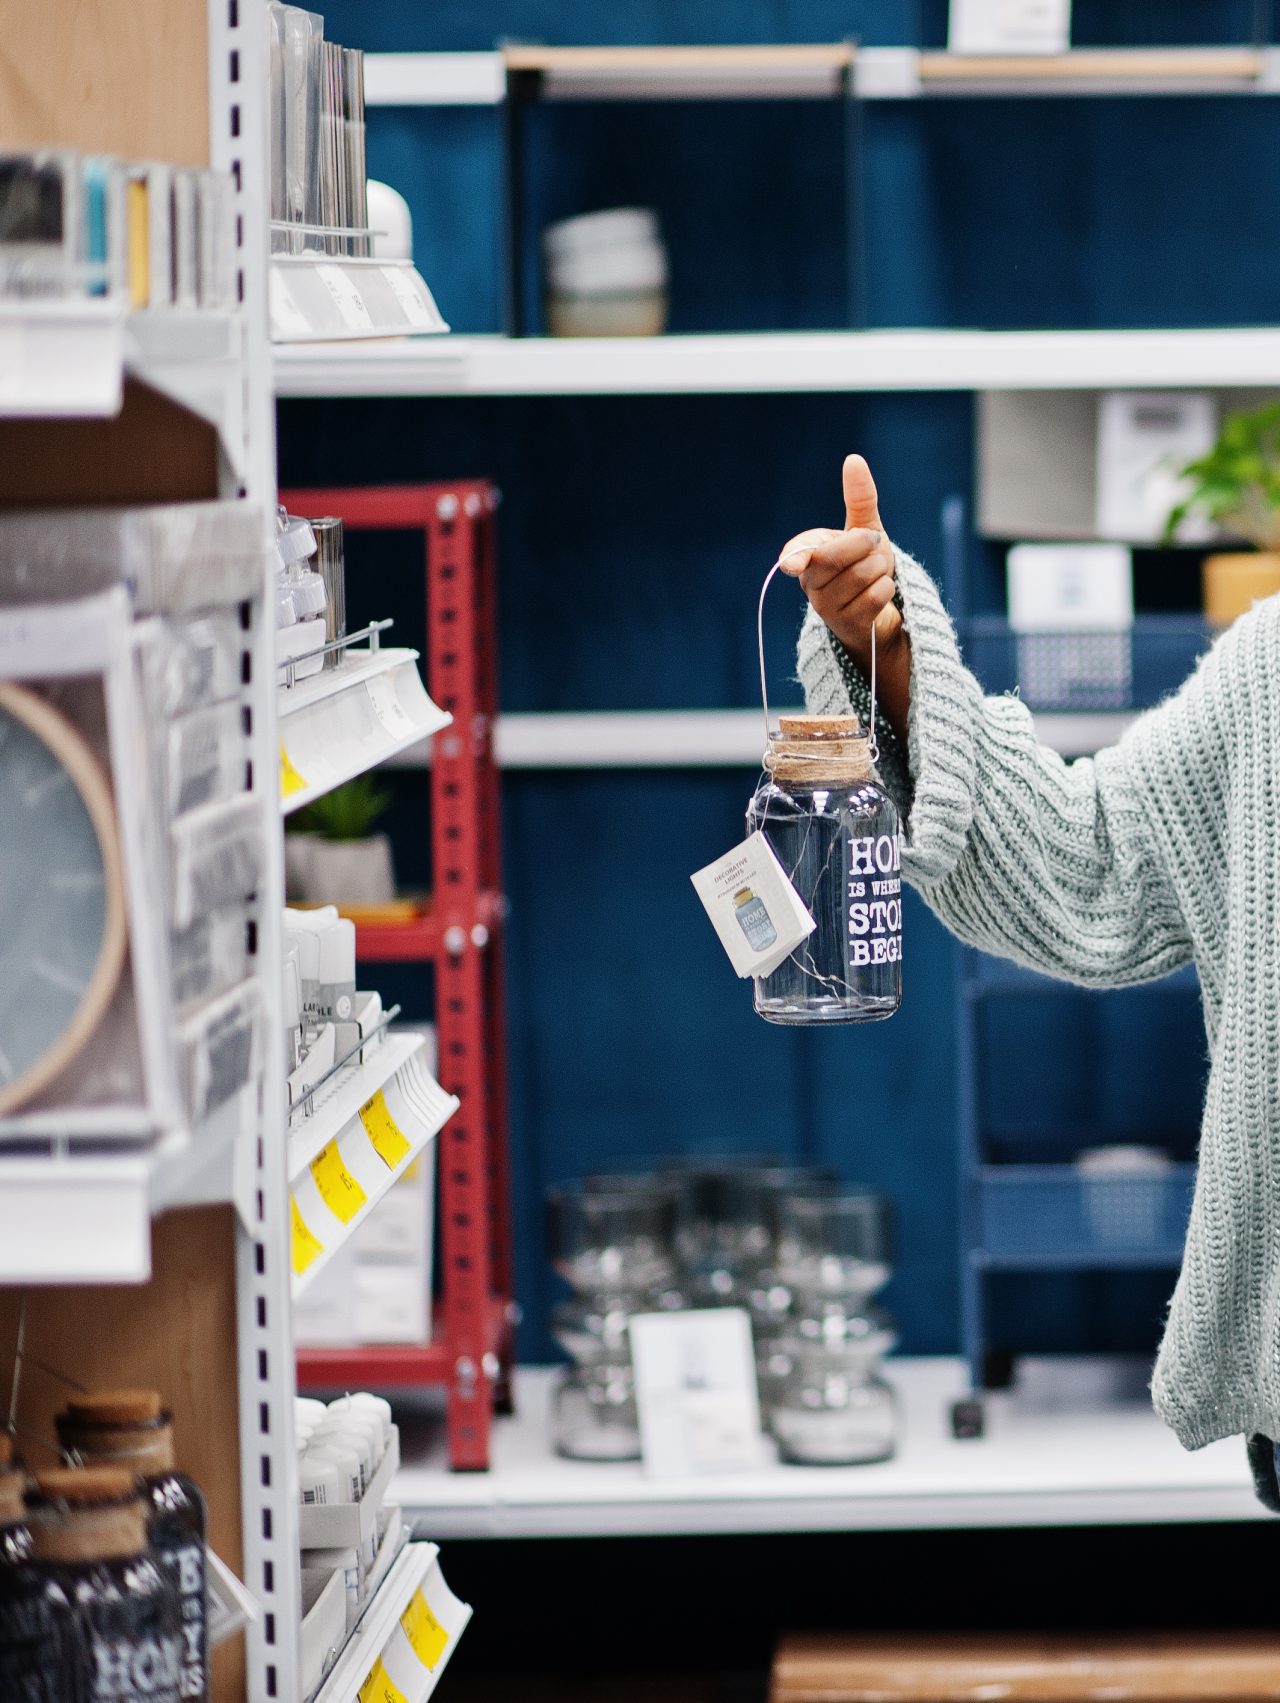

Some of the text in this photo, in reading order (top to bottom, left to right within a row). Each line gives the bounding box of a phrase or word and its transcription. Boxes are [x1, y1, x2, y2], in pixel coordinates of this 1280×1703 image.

[713, 857, 749, 884] DECORATIVE
[724, 868, 746, 885] LIGHTS
[847, 881, 866, 898] IS
